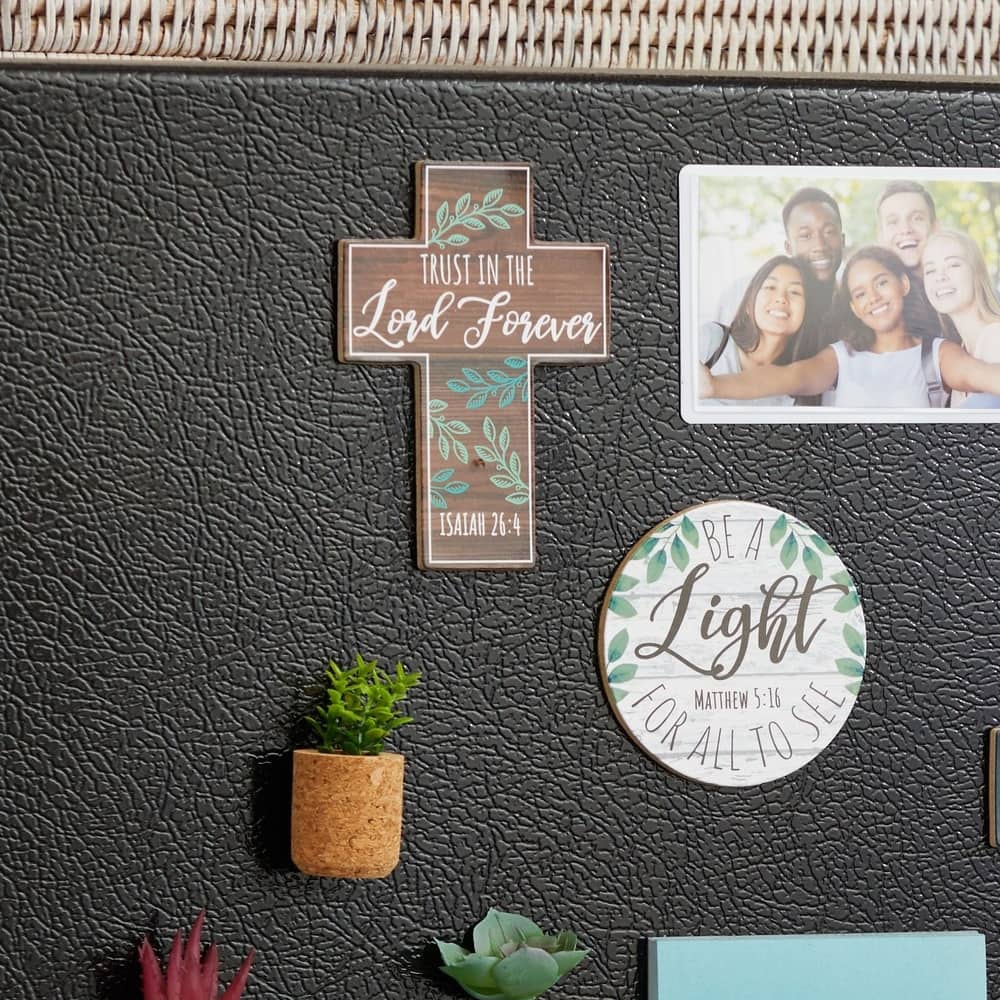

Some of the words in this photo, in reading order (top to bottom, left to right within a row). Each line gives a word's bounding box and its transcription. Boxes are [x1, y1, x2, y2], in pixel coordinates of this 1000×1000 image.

[421, 254, 474, 286] TRUST
[479, 254, 500, 285] IN
[505, 254, 533, 286] THE
[353, 279, 454, 348] Lord
[457, 291, 601, 348] Forever
[440, 512, 486, 537] ISAIAH
[491, 512, 520, 537] 26:4
[702, 515, 734, 562] BE
[745, 518, 764, 560] A
[634, 563, 850, 680] Light
[754, 687, 781, 709] 5:16
[632, 684, 688, 751] FOR
[688, 726, 740, 771] ALL
[750, 720, 792, 767] TO
[792, 682, 846, 742] SEE
